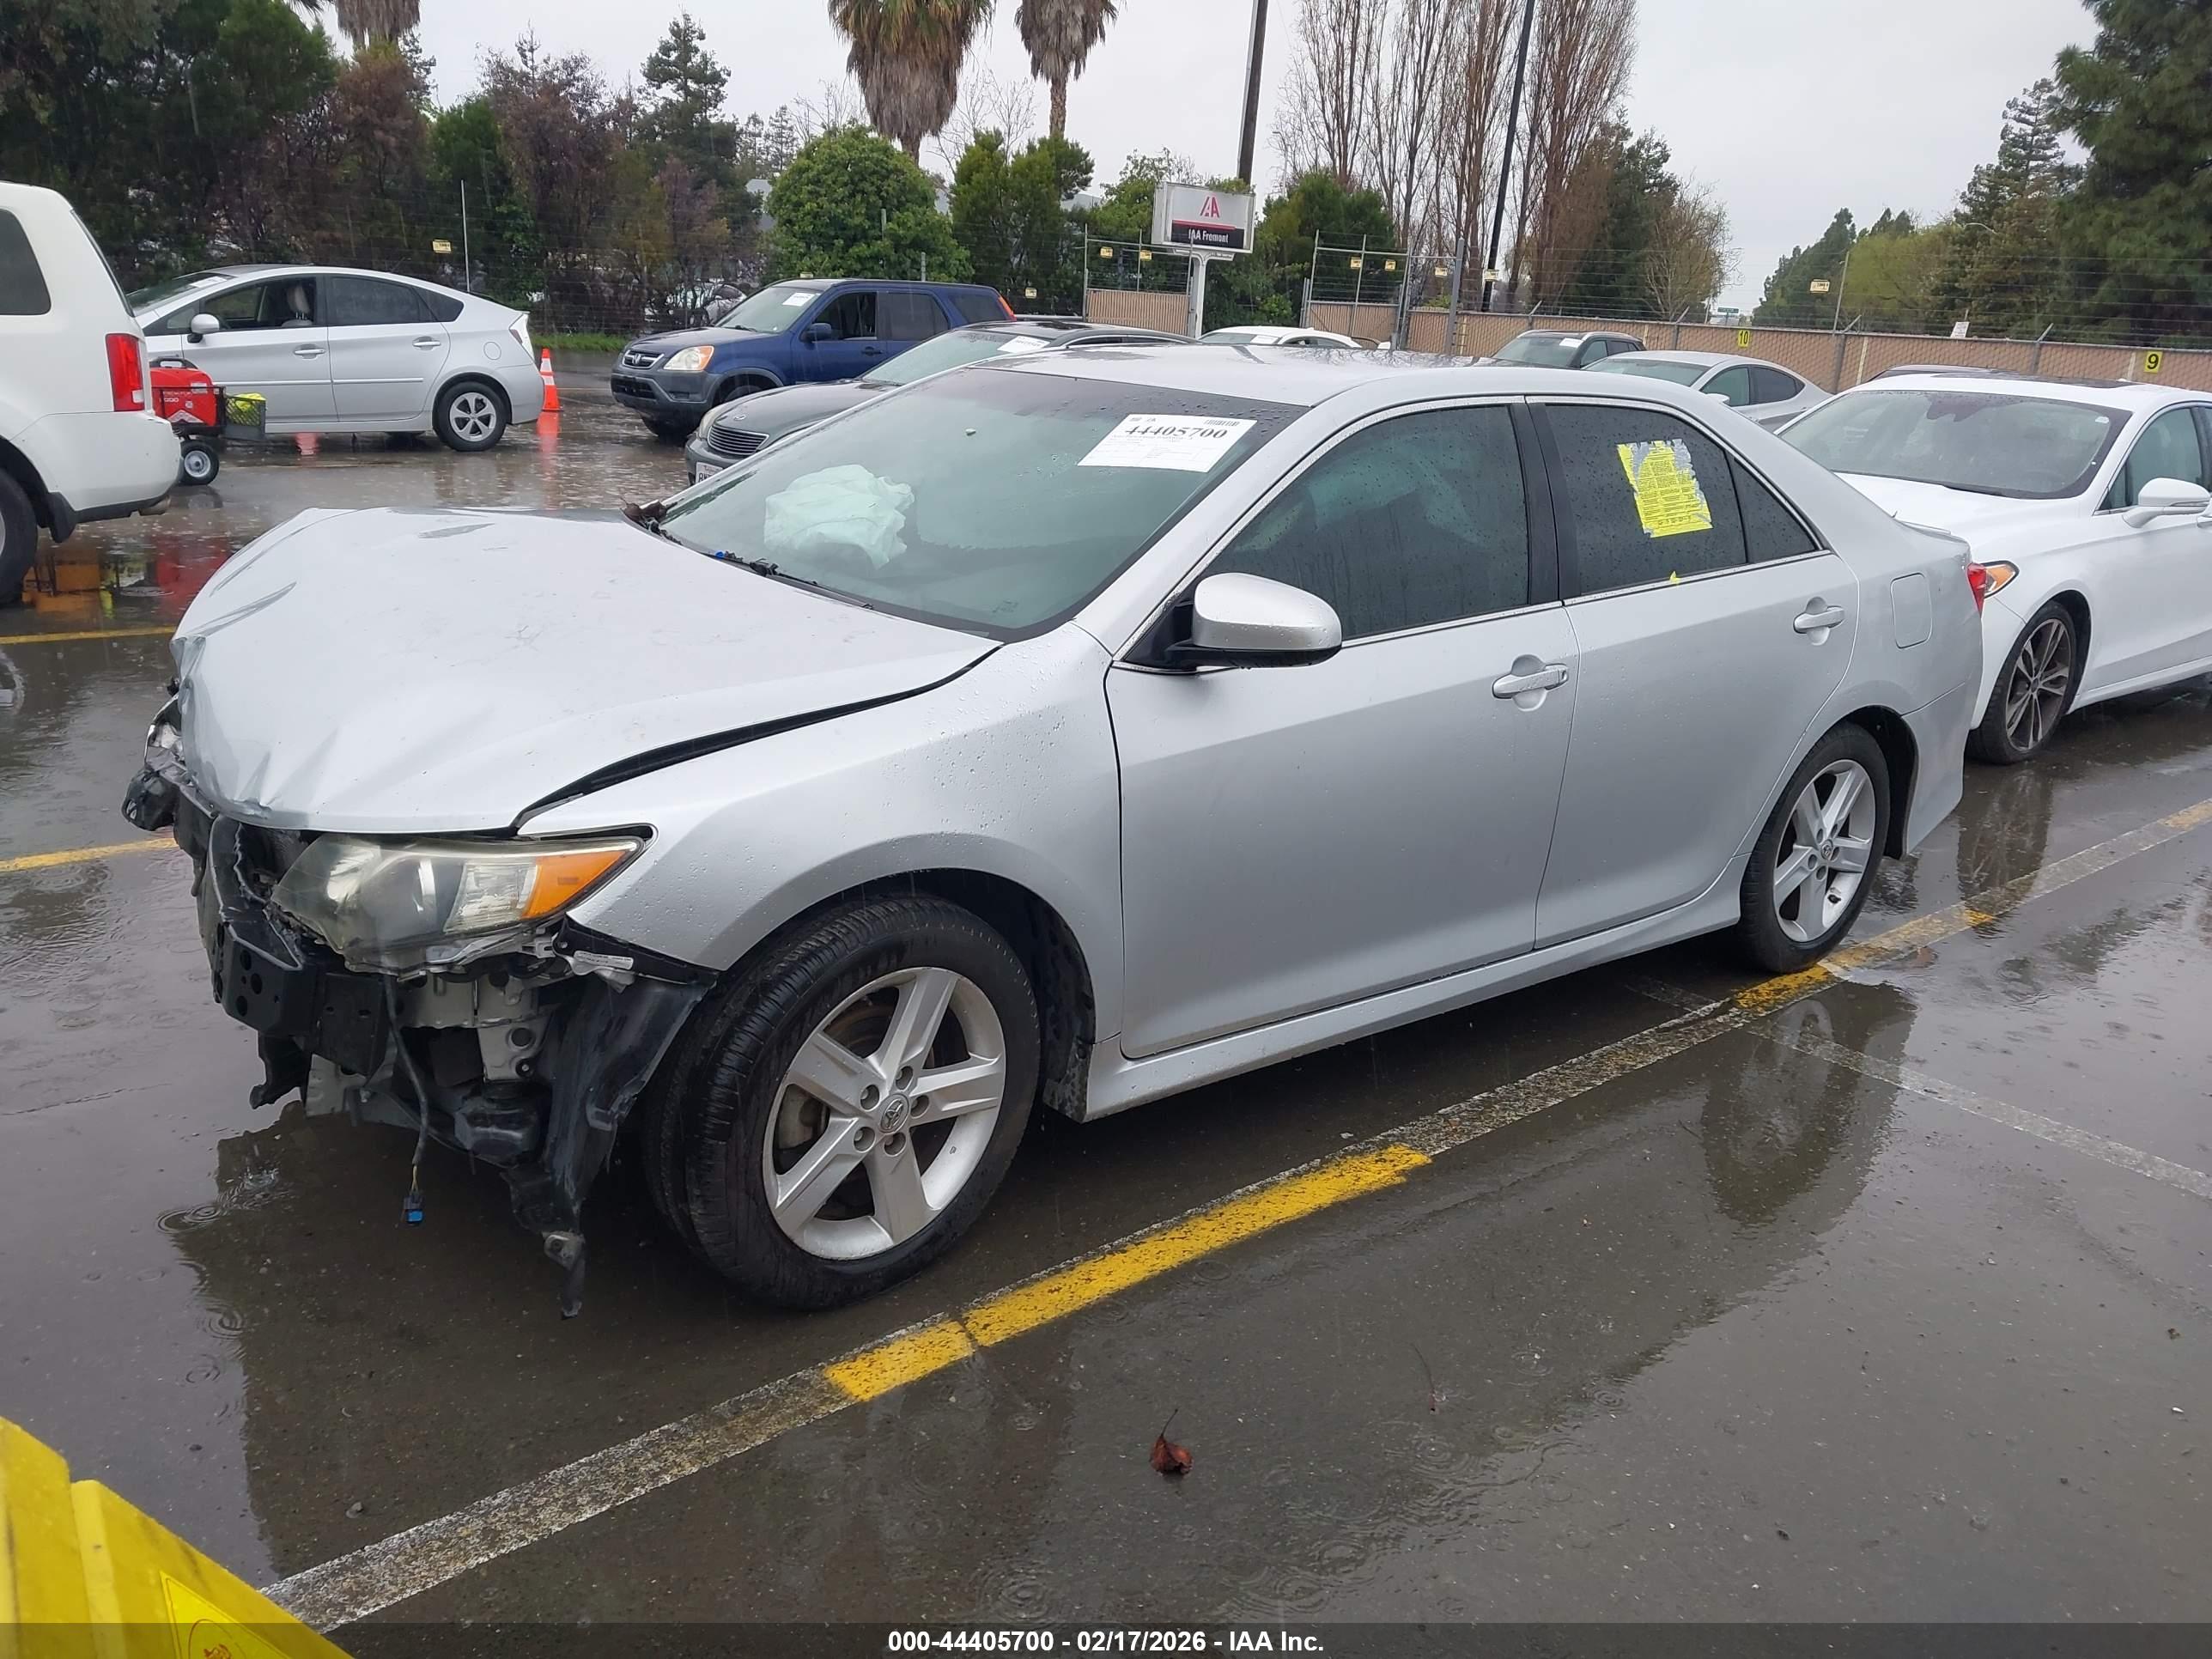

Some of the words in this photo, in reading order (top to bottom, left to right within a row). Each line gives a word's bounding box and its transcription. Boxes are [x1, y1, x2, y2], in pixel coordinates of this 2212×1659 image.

[1202, 230, 1229, 243] Fremont
[1739, 330, 1749, 344] 10
[2147, 353, 2160, 370] 9
[1125, 425, 1228, 439] 44405700
